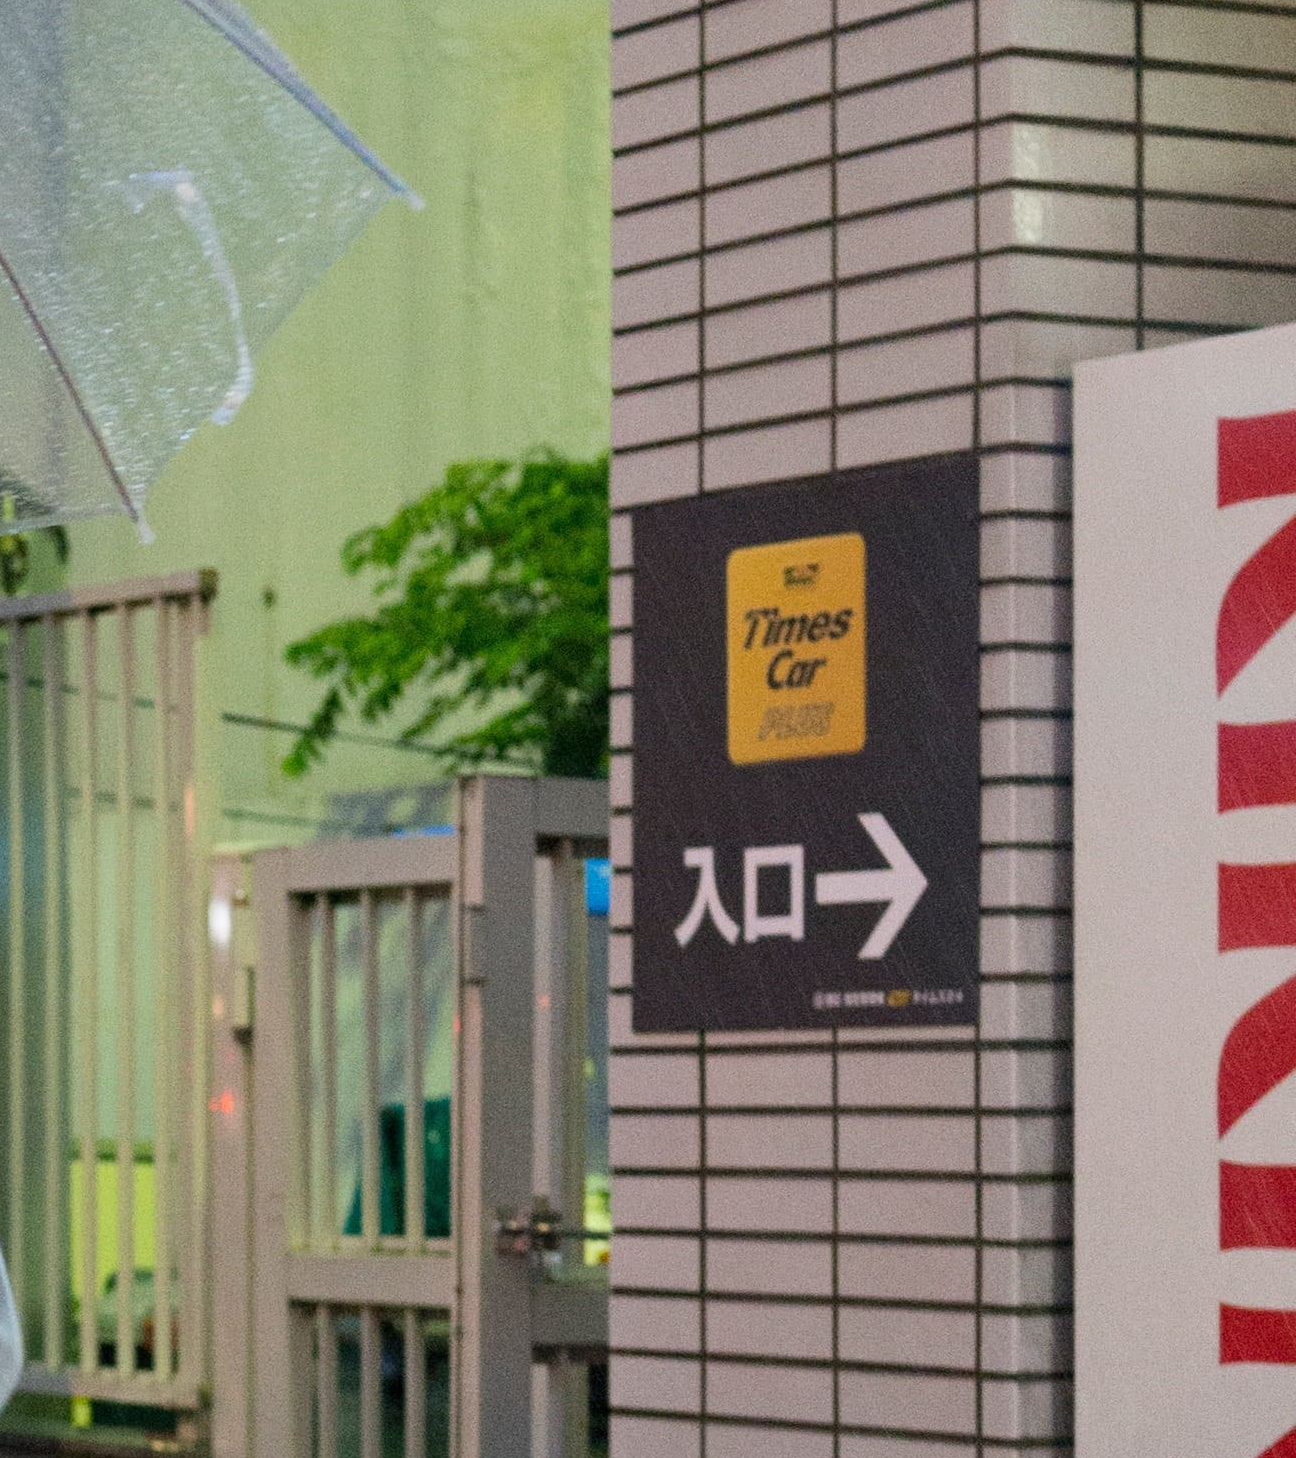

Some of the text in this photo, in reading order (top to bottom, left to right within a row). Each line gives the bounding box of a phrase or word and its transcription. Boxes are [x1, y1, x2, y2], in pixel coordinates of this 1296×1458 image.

[743, 607, 854, 651] Times
[766, 649, 828, 690] Car
[673, 845, 806, 946] 入口
